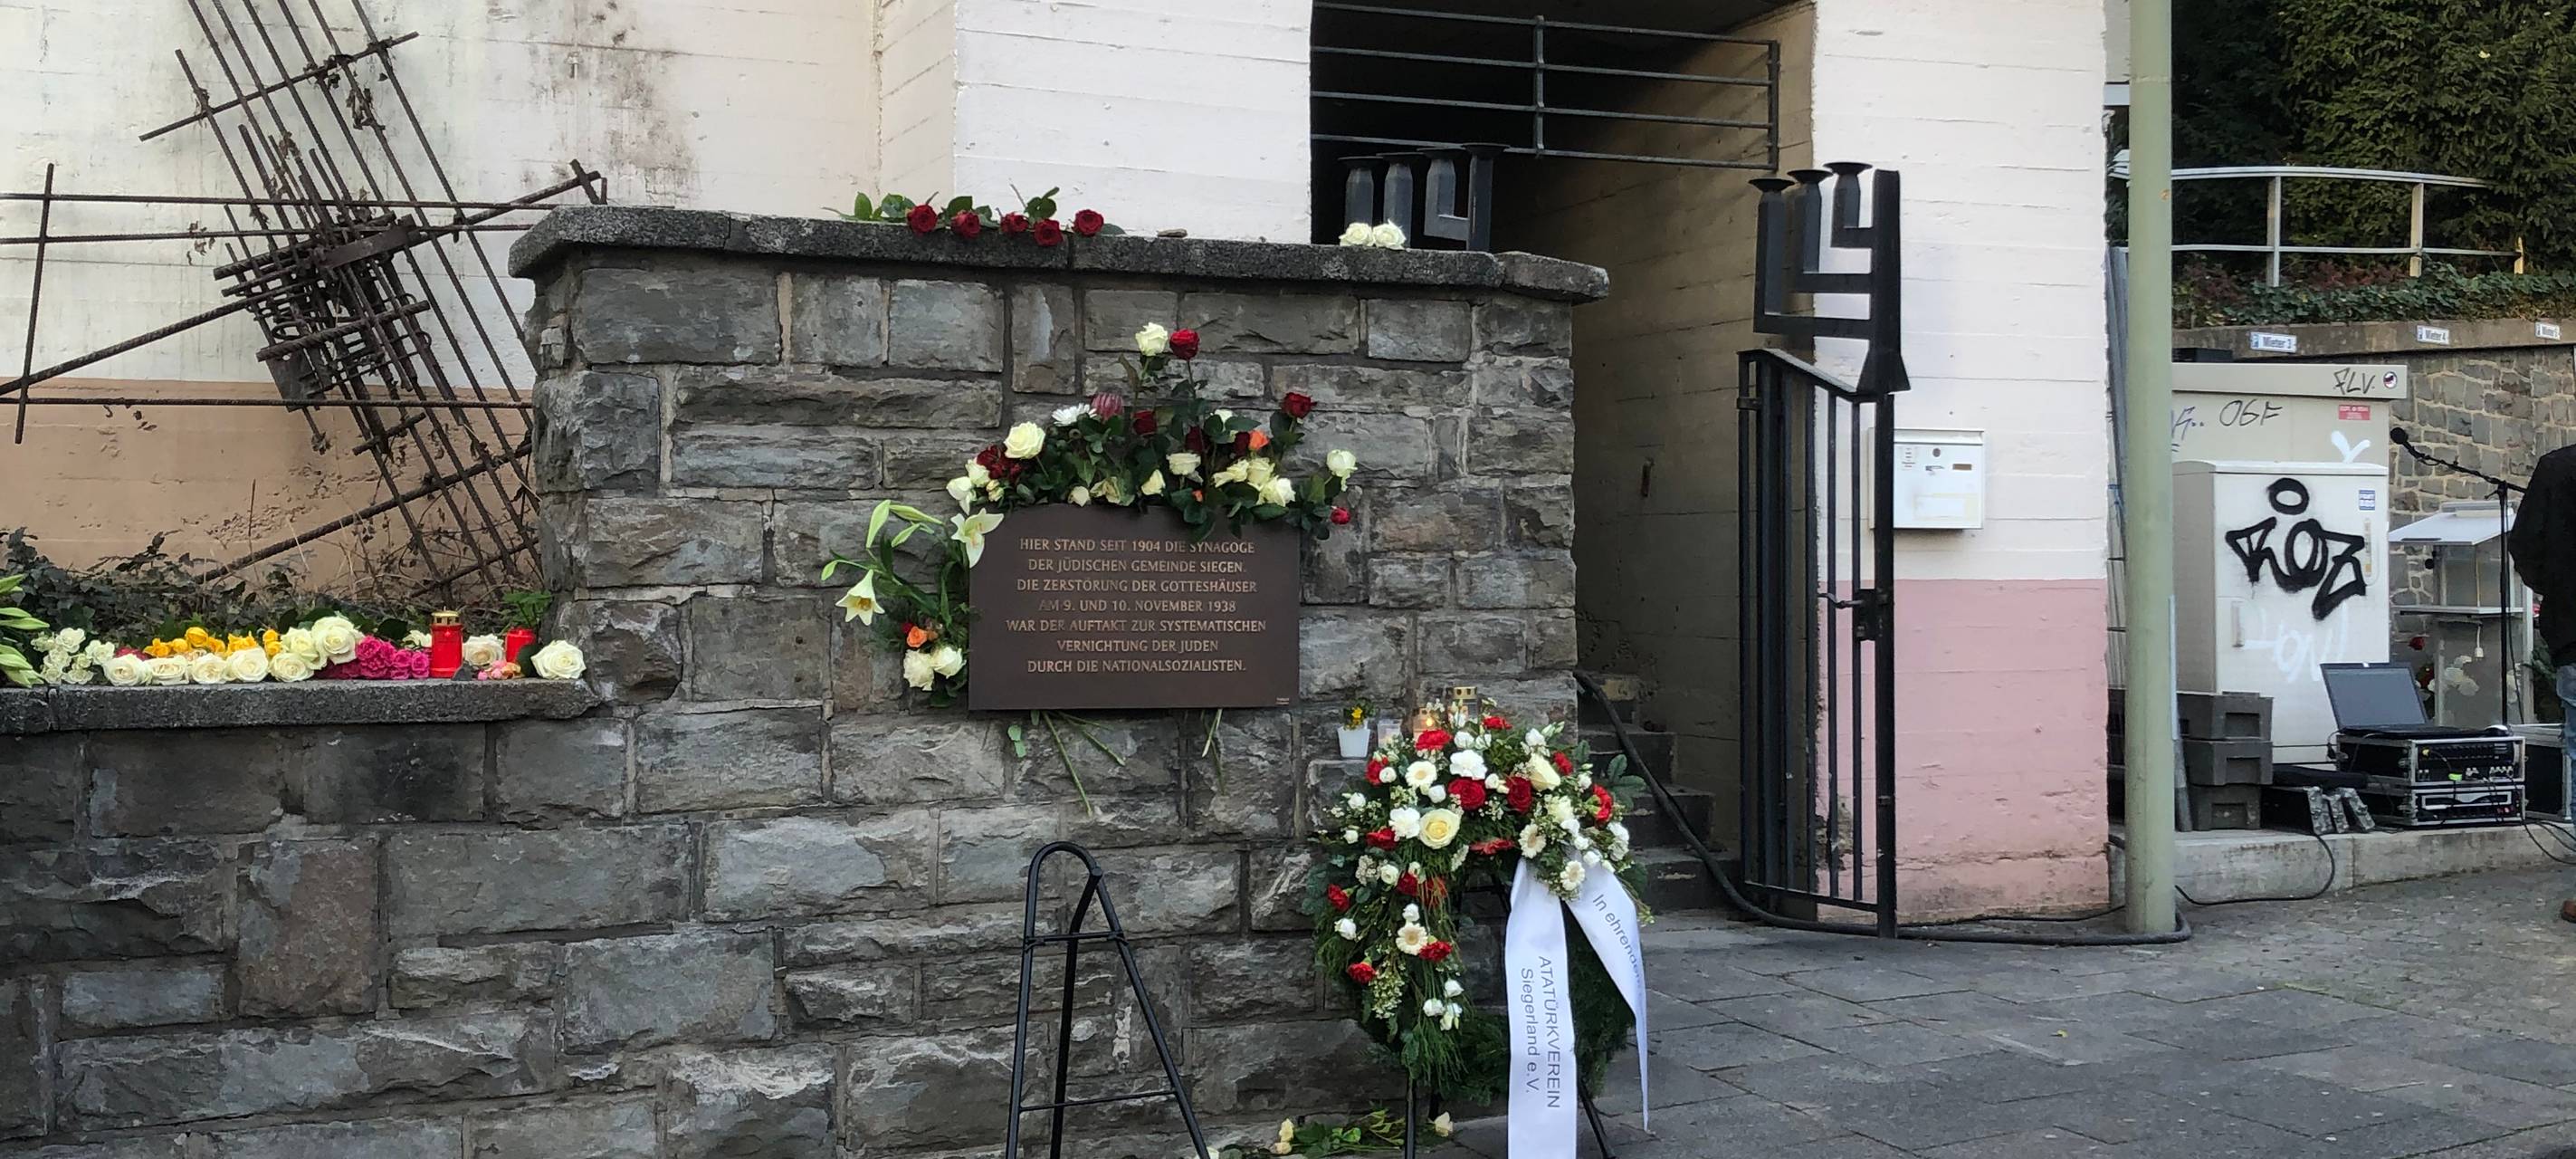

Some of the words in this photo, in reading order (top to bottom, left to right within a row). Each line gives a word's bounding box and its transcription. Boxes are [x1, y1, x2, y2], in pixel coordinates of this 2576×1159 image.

[1020, 538, 1050, 551] HIER
[1054, 539, 1096, 551] STAND
[1100, 540, 1127, 551] SEIT
[1132, 540, 1160, 552] 1904
[1165, 541, 1186, 553] DIE
[1189, 541, 1255, 553] SYNAGOGE
[1028, 559, 1054, 570] DER
[1056, 556, 1127, 573] JÜDISCHEN
[1131, 560, 1196, 572] GEMEINDE
[1199, 561, 1246, 573] SIEGEN.
[1016, 579, 1040, 591] DIE
[1132, 580, 1157, 592] DER
[1160, 578, 1257, 592] GOTTESHÄUSER
[1039, 599, 1059, 611] AM
[1063, 599, 1075, 611] 9.
[1079, 599, 1107, 612] UND
[1112, 599, 1131, 612] 10.
[1135, 599, 1203, 612] NOVEMBER
[1208, 600, 1236, 613] 1938
[1007, 619, 1035, 632] WAR
[1040, 619, 1065, 631] DER
[1070, 619, 1128, 632] AUFTAKT
[1131, 619, 1156, 632] ZUR
[1159, 619, 1266, 632] SYSTEMATISCHEN
[1057, 639, 1148, 652] VERNICHTUNG
[1152, 639, 1177, 652] DER
[1179, 639, 1218, 654] JUDEN
[1027, 660, 1072, 673] DURCH
[1076, 660, 1099, 673] DIE
[1102, 659, 1246, 673] NATIONALSOZIALISTEN.
[1592, 894, 1608, 912] In
[1520, 967, 1541, 1056] Siegerland
[1538, 955, 1561, 1108] ATATÜRKVEREIN
[1525, 1061, 1540, 1093] e.V.
